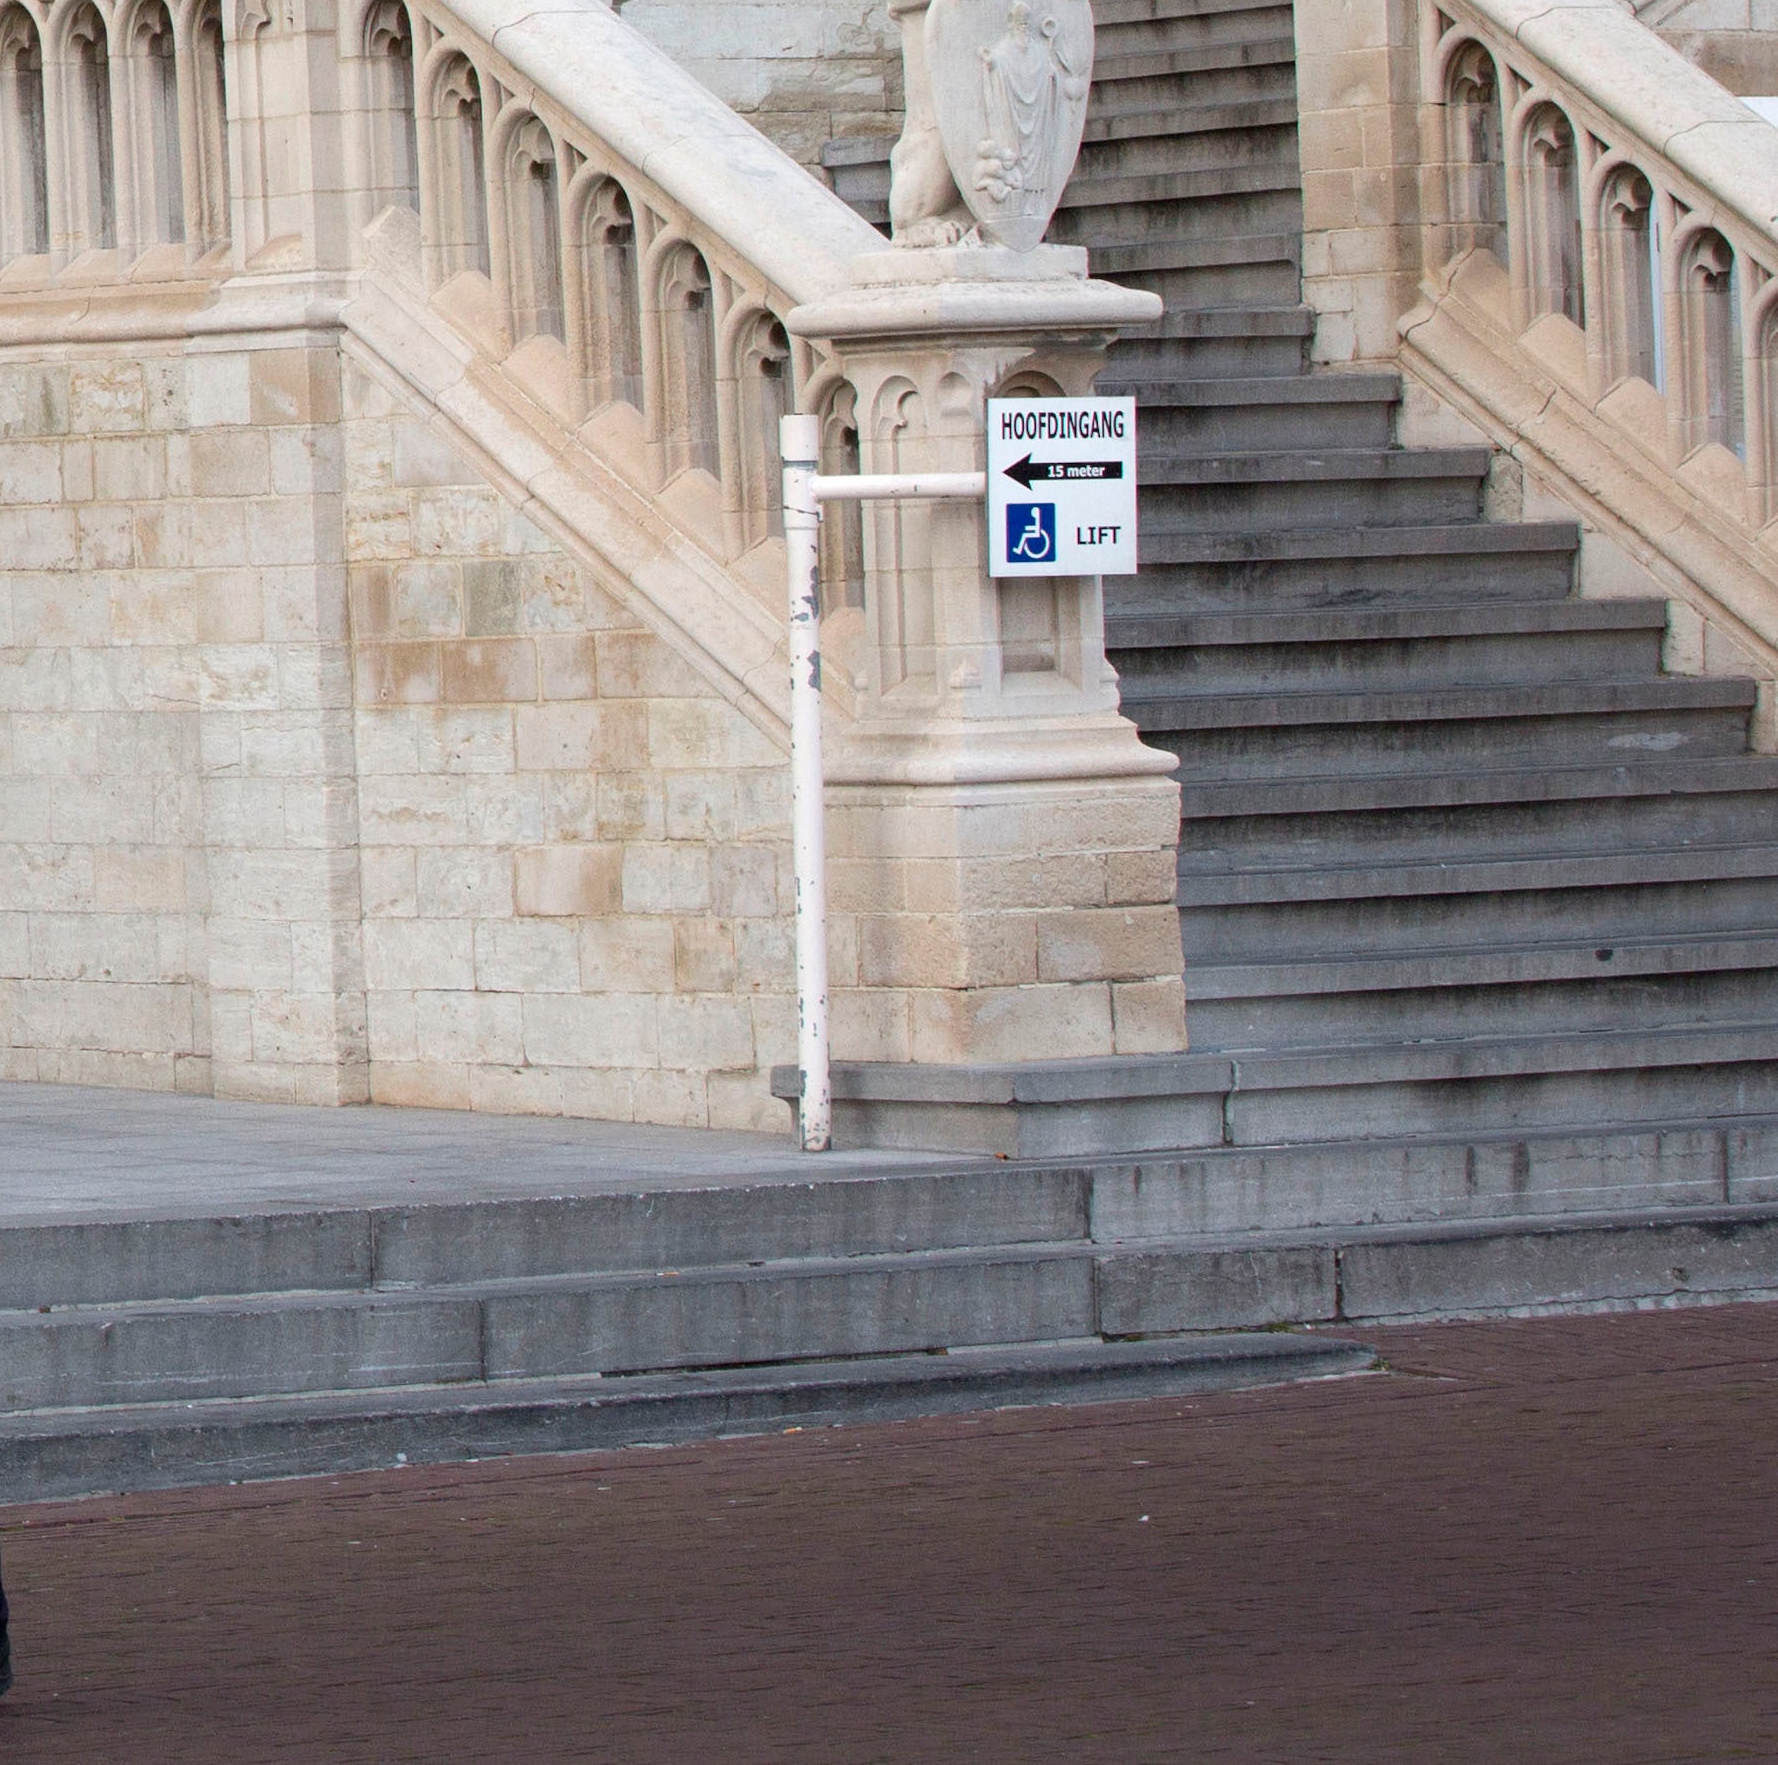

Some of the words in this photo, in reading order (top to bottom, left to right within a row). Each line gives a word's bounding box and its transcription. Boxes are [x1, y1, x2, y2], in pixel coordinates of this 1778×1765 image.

[1001, 411, 1124, 440] HOOFDINGANG
[1048, 465, 1064, 478] 15
[1067, 465, 1105, 477] meter
[1076, 526, 1121, 545] LIFT
